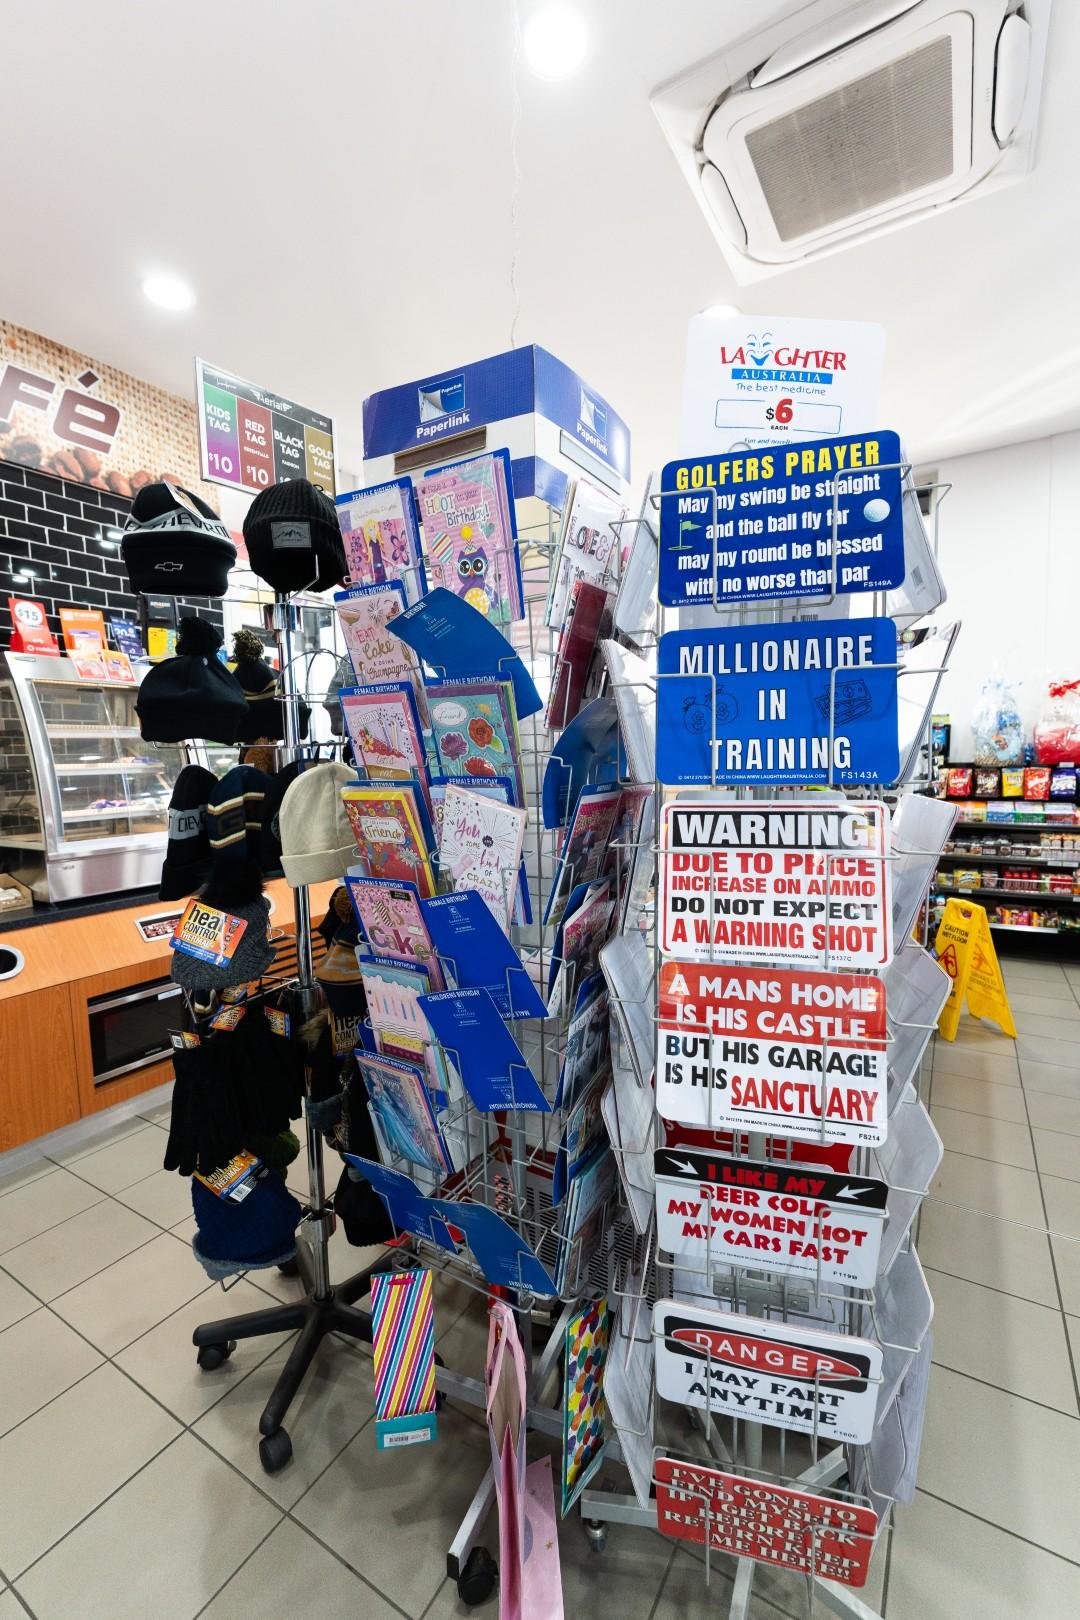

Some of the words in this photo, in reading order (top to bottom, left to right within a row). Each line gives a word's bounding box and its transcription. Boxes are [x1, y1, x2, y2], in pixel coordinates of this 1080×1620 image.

[741, 370, 821, 383] AUSTRALIA
[736, 383, 753, 392] The
[756, 383, 778, 392] best
[781, 384, 826, 396] medicine
[207, 403, 231, 421] KIDS
[765, 398, 794, 424] $6
[207, 416, 231, 432] TAG
[245, 418, 265, 434] RED
[416, 412, 471, 438] Paperlink
[245, 430, 266, 446] TAG
[273, 429, 304, 450] BLACK
[576, 422, 609, 456] Paperlink
[280, 443, 299, 458] TAG
[308, 443, 333, 460] GOLD
[312, 455, 330, 470] TAG
[208, 452, 233, 474] $10
[246, 465, 269, 485] $10
[676, 455, 775, 490] GOLFERS
[785, 440, 880, 476] PRAYER
[425, 493, 455, 516] HOOT
[678, 495, 709, 515] May
[716, 493, 736, 512] my
[740, 483, 786, 508] swing
[791, 480, 811, 499] be
[815, 473, 881, 497] straight
[446, 503, 490, 527] Birthday!
[705, 518, 734, 540] and
[738, 517, 763, 536] the
[767, 513, 797, 532] ball
[801, 510, 822, 530] fly
[826, 507, 849, 526] far
[678, 553, 710, 570] may
[716, 550, 737, 569] my
[741, 544, 787, 565] round
[791, 541, 812, 559] be
[816, 533, 883, 556] blessed
[348, 588, 369, 598] FEMALE
[369, 583, 393, 596] BIRTHDAY
[685, 579, 715, 596] with
[722, 576, 742, 594] no
[746, 571, 797, 591] worse
[800, 568, 834, 588] than
[841, 564, 870, 584] par
[18, 607, 39, 622] $15
[356, 625, 374, 644] EAT
[362, 639, 395, 660] Cake
[679, 635, 874, 676] MILLIONAIRE
[354, 686, 375, 696] FEMALE
[375, 684, 400, 694] BIRTHDAY
[442, 677, 466, 686] FEMALE
[466, 675, 496, 685] BIRTHDAY
[758, 688, 787, 721] IN
[709, 736, 852, 771] TRAINING
[471, 777, 498, 785] BIRTHDAY
[841, 771, 879, 780] FS143A
[675, 812, 869, 848] WARNING
[672, 852, 729, 873] DUE
[736, 852, 773, 875] TO
[784, 853, 877, 877] PRICE
[358, 879, 378, 888] FEMALE
[379, 880, 404, 889] BIRTHDAY
[672, 876, 767, 894] INCREASE
[773, 877, 802, 895] ON
[807, 879, 876, 897] AMMO
[427, 899, 447, 907] FEMALE
[447, 894, 469, 904] BIRTHDAY
[672, 897, 705, 914] DO
[713, 899, 765, 916] NOT
[773, 900, 878, 921] EXPECT
[183, 920, 219, 942] CONTROL
[368, 925, 431, 961] Cake
[672, 919, 688, 943] A
[693, 920, 805, 948] WARNING
[812, 925, 878, 952] SHOT
[944, 924, 970, 938] CAUTION
[375, 957, 393, 966] FAMILY
[393, 959, 417, 970] BIRTHDAY
[427, 992, 457, 1002] CHILDRENS
[457, 989, 480, 998] BIRTHDAY
[668, 973, 690, 996] A
[699, 977, 782, 1003] MANS
[791, 985, 877, 1012] HOME
[676, 1003, 697, 1024] IS
[706, 1006, 747, 1030] HIS
[756, 1011, 866, 1039] CASTLE
[665, 1034, 715, 1060] BUT
[722, 1041, 760, 1065] HIS
[768, 1045, 878, 1078] GARAGE
[665, 1062, 683, 1085] IS
[692, 1065, 728, 1090] HIS
[730, 1075, 879, 1123] SANCTUARY
[858, 1133, 880, 1142] FS214
[212, 1165, 242, 1190] THERMAL
[707, 1163, 716, 1180] I
[722, 1166, 777, 1189] LIKE
[783, 1176, 827, 1196] MY
[699, 1184, 760, 1207] BEER
[767, 1195, 833, 1219] COLD
[667, 1199, 702, 1218] MY
[710, 1206, 806, 1237] WOMEN
[812, 1223, 868, 1247] HOT
[681, 1222, 716, 1240] MY
[723, 1229, 782, 1253] CARS
[789, 1240, 850, 1265] FAST
[695, 1333, 836, 1376] DANGER
[685, 1361, 695, 1374] I
[703, 1366, 760, 1390] MAY
[770, 1382, 846, 1407] FART
[688, 1382, 838, 1427] ANYTIME
[671, 1479, 735, 1503] FIND
[746, 1498, 858, 1532] MYSELF
[672, 1468, 725, 1490] I'VE
[733, 1484, 810, 1511] GONE
[820, 1504, 857, 1522] TO
[669, 1488, 694, 1502] IF
[720, 1503, 774, 1524] GET
[783, 1518, 857, 1547] BACK
[698, 1507, 804, 1544] BEFORE
[664, 1510, 774, 1548] RETURN
[784, 1542, 861, 1569] KEEP
[711, 1533, 751, 1552] ME
